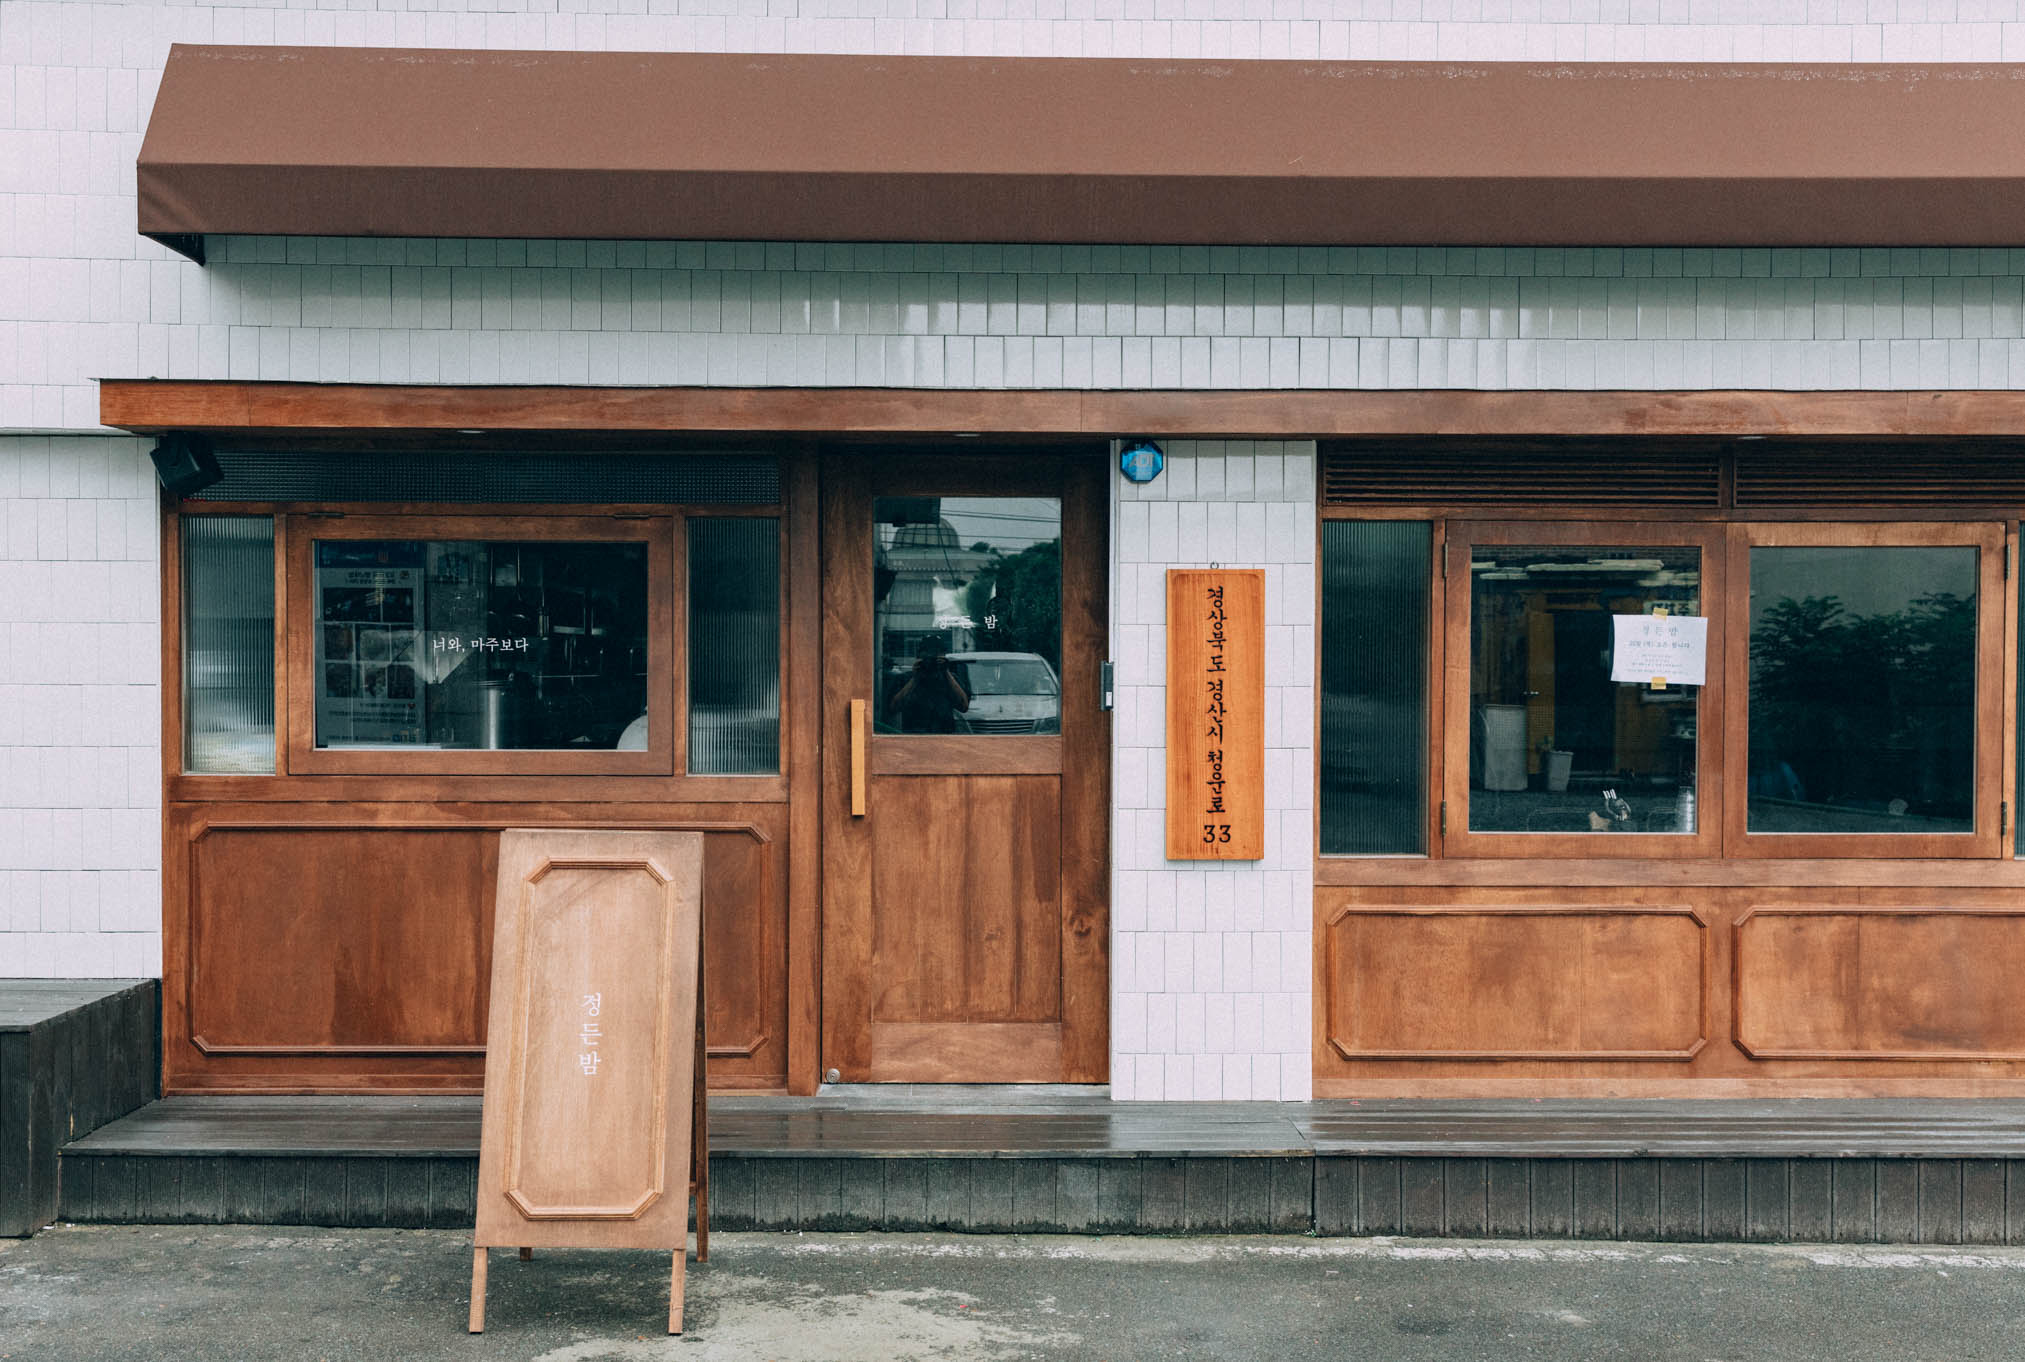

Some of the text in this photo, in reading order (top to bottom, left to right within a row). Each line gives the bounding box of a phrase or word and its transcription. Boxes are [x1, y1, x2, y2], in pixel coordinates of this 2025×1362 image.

[432, 636, 529, 653] 너와, 마주보다
[1203, 585, 1231, 843] 경상북도 경산시 청운로 33
